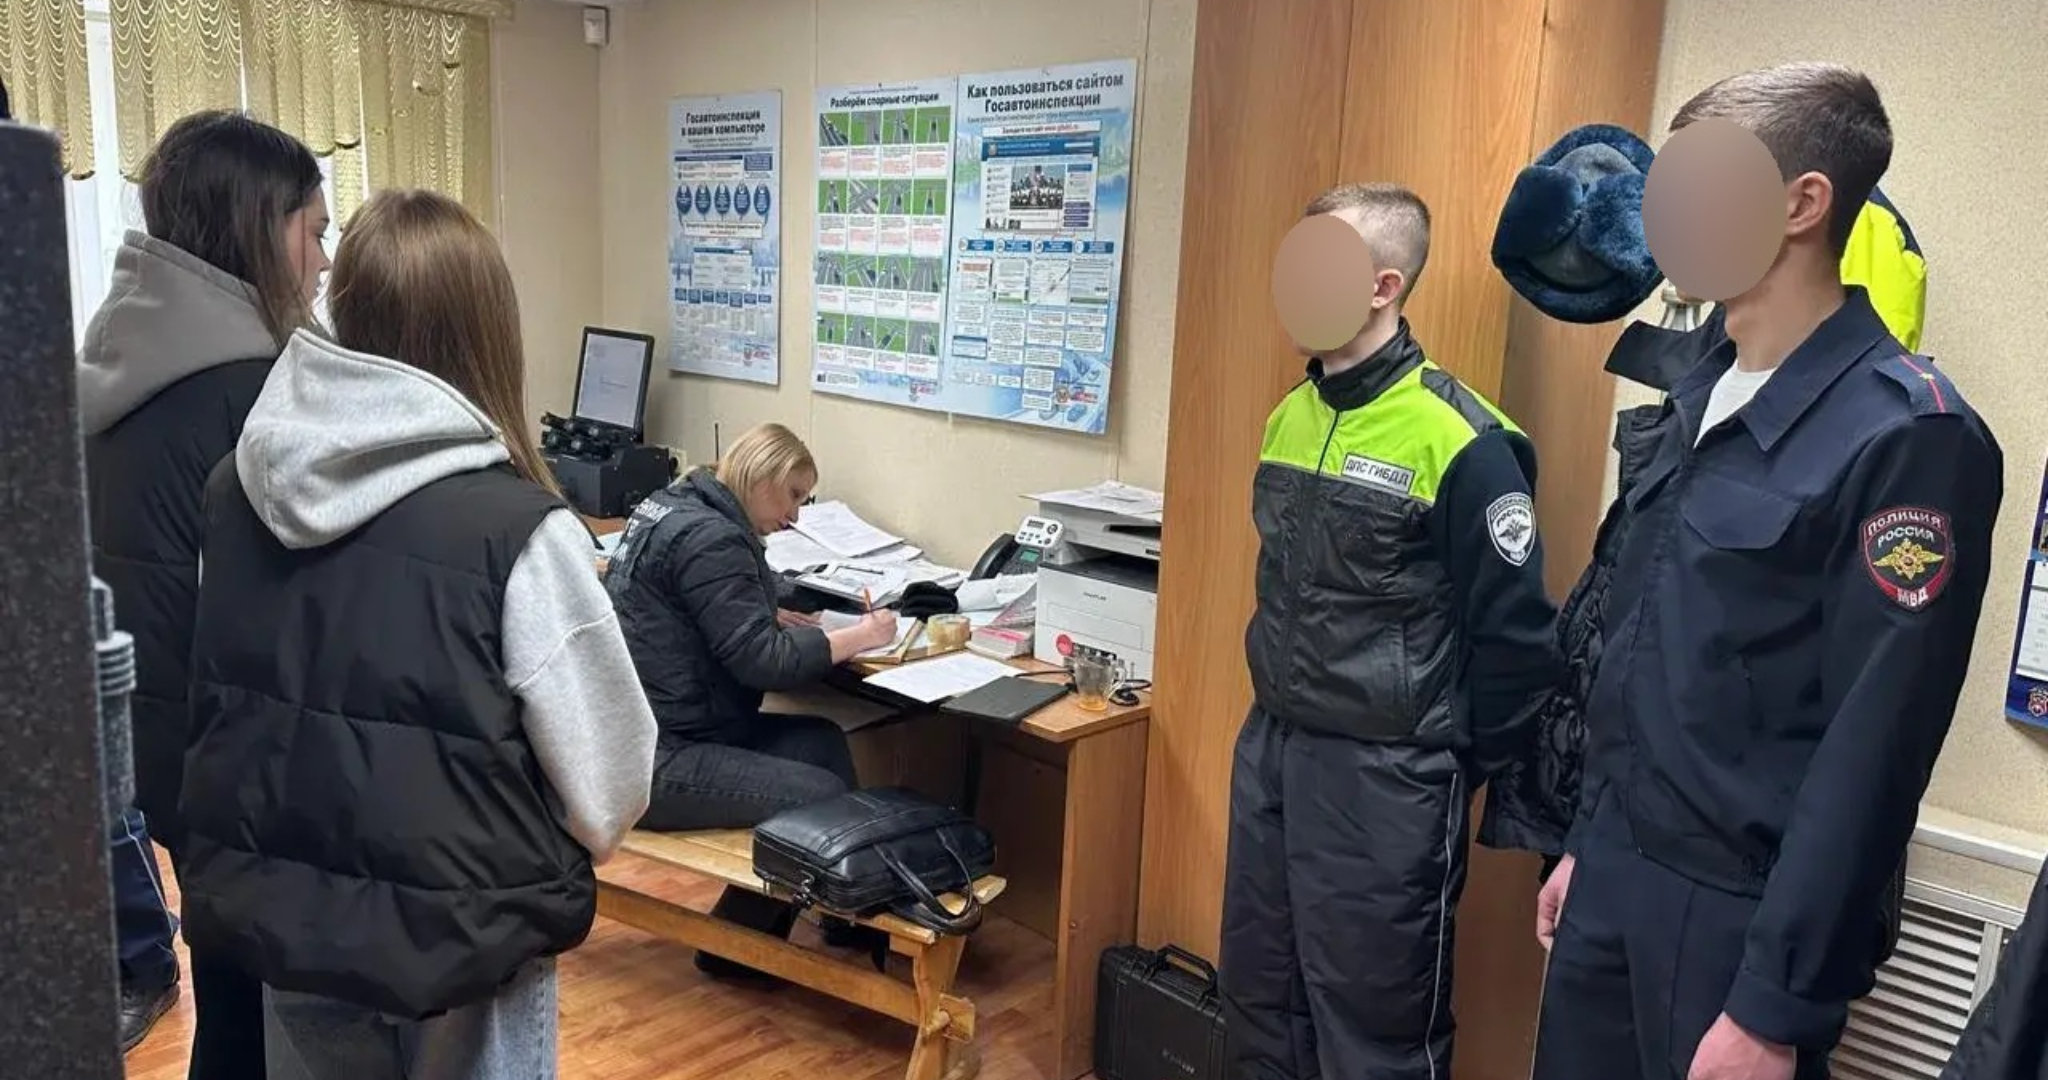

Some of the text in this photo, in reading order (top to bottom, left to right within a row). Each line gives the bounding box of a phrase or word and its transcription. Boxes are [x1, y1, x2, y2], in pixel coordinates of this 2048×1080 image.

[967, 73, 1123, 98] Как пользоваться сайтом
[830, 92, 939, 109] Разберём спорные ситуации
[985, 93, 1101, 113] Госавтоинспекции
[688, 125, 714, 136] вашем
[715, 123, 766, 137] компьютере
[1345, 459, 1410, 486] ДПС ГИБДД
[1497, 507, 1529, 527] РОССИЯ
[1867, 510, 1941, 537] ПОЛИЦИЯ
[1877, 525, 1935, 548] РОССИЯ
[1897, 586, 1928, 607] МВД
